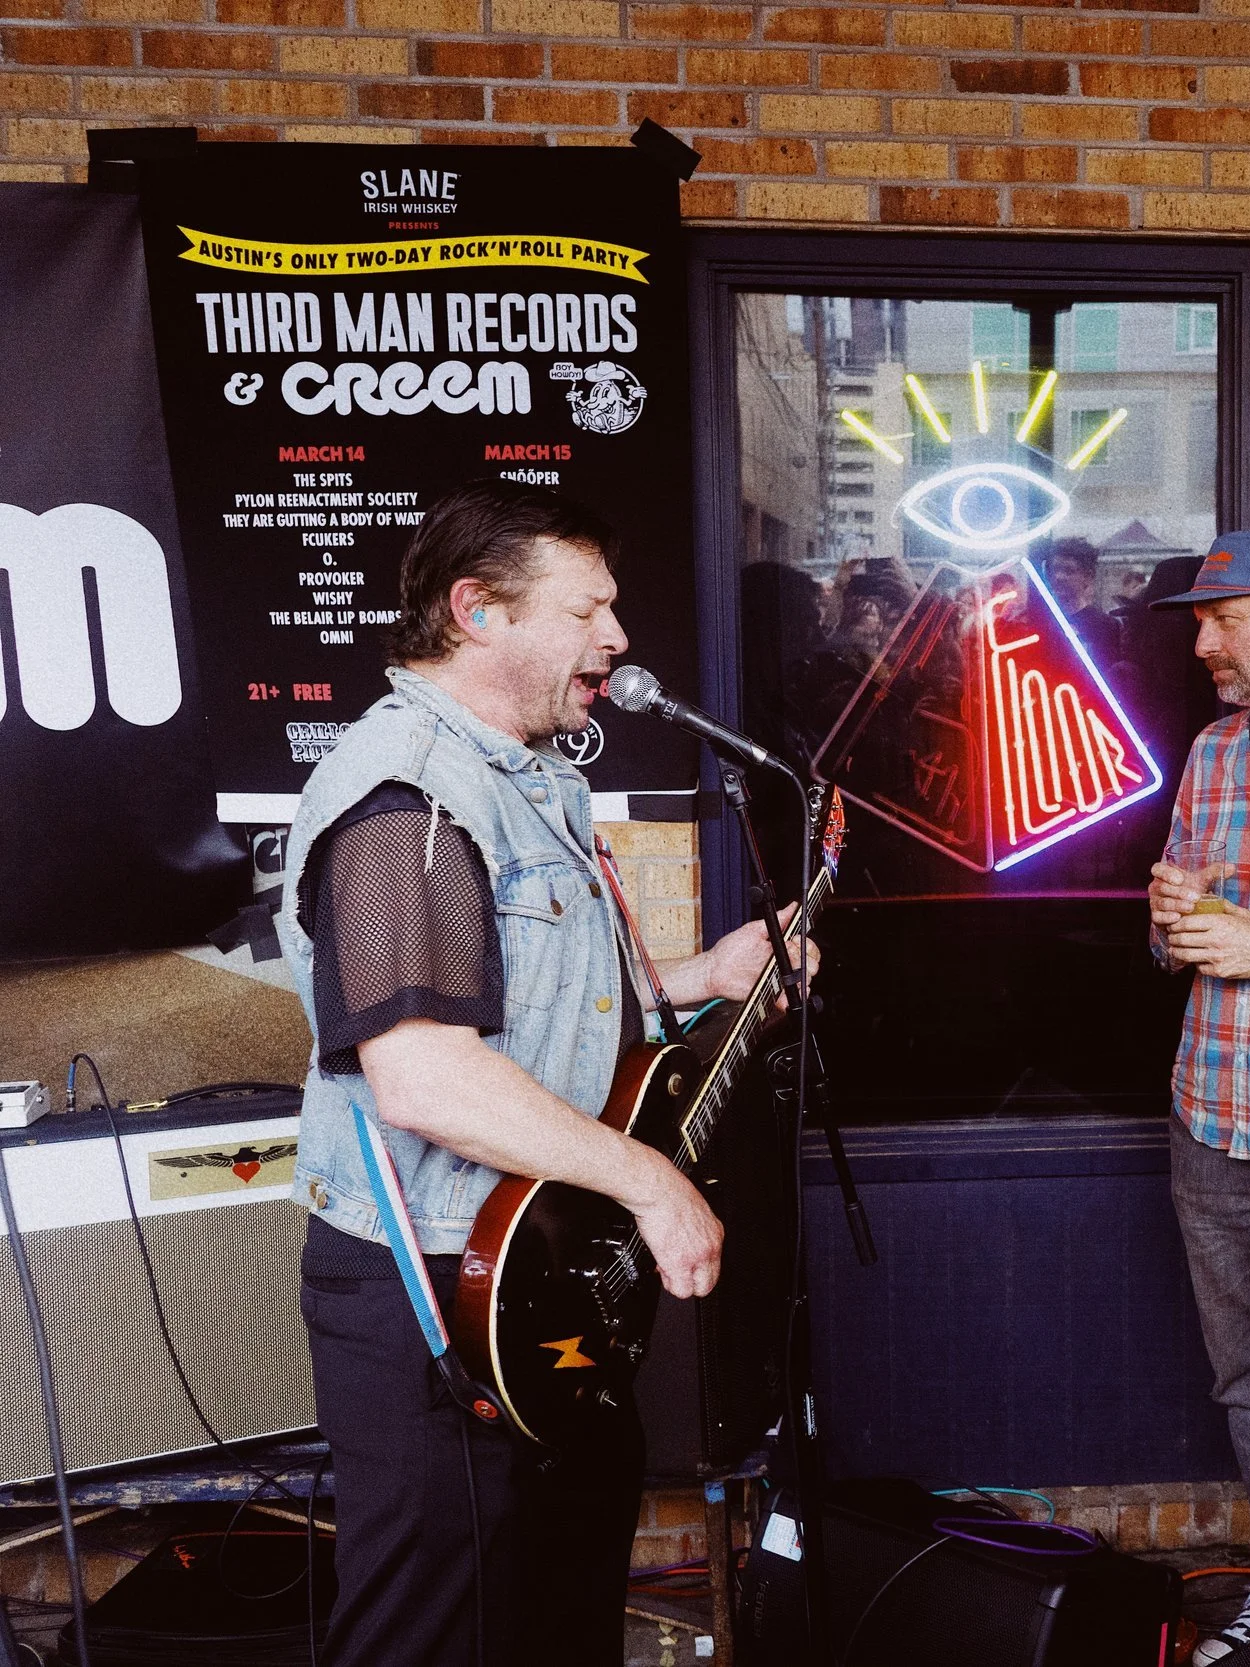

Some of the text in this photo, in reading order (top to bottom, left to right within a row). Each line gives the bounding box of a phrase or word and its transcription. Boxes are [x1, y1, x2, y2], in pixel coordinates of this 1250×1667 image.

[360, 168, 458, 200] SLANE
[363, 203, 458, 214] IRISH WHISKEY
[388, 221, 440, 230] PRESENTS
[199, 239, 283, 268] AUSTIN'S
[291, 253, 338, 269] ONLY
[346, 247, 432, 268] TWO-DAY
[571, 244, 630, 270] PARTY
[196, 292, 638, 353] THIRD MAN RECORDS
[224, 371, 264, 406] &
[279, 446, 365, 462] MARCH 14
[485, 444, 571, 461] MARCH 15
[293, 473, 353, 487] THE SPITS
[235, 492, 418, 508] PYLON REENACTMENT SOCIETY
[223, 514, 250, 528] THEY
[252, 513, 274, 527] ARE
[276, 513, 326, 527] GUTTING
[329, 512, 339, 526] A
[341, 512, 373, 526] BODY
[376, 512, 392, 526] OF
[302, 533, 354, 546] FCUKERS
[322, 552, 337, 566] O.
[299, 572, 365, 586] PROVOKER
[312, 592, 353, 605] WISHY
[269, 611, 290, 625] THE
[294, 611, 334, 625] BELAIR
[337, 611, 355, 624] LIP
[320, 630, 354, 644] OMNI
[248, 683, 332, 701] 21+ FREE
